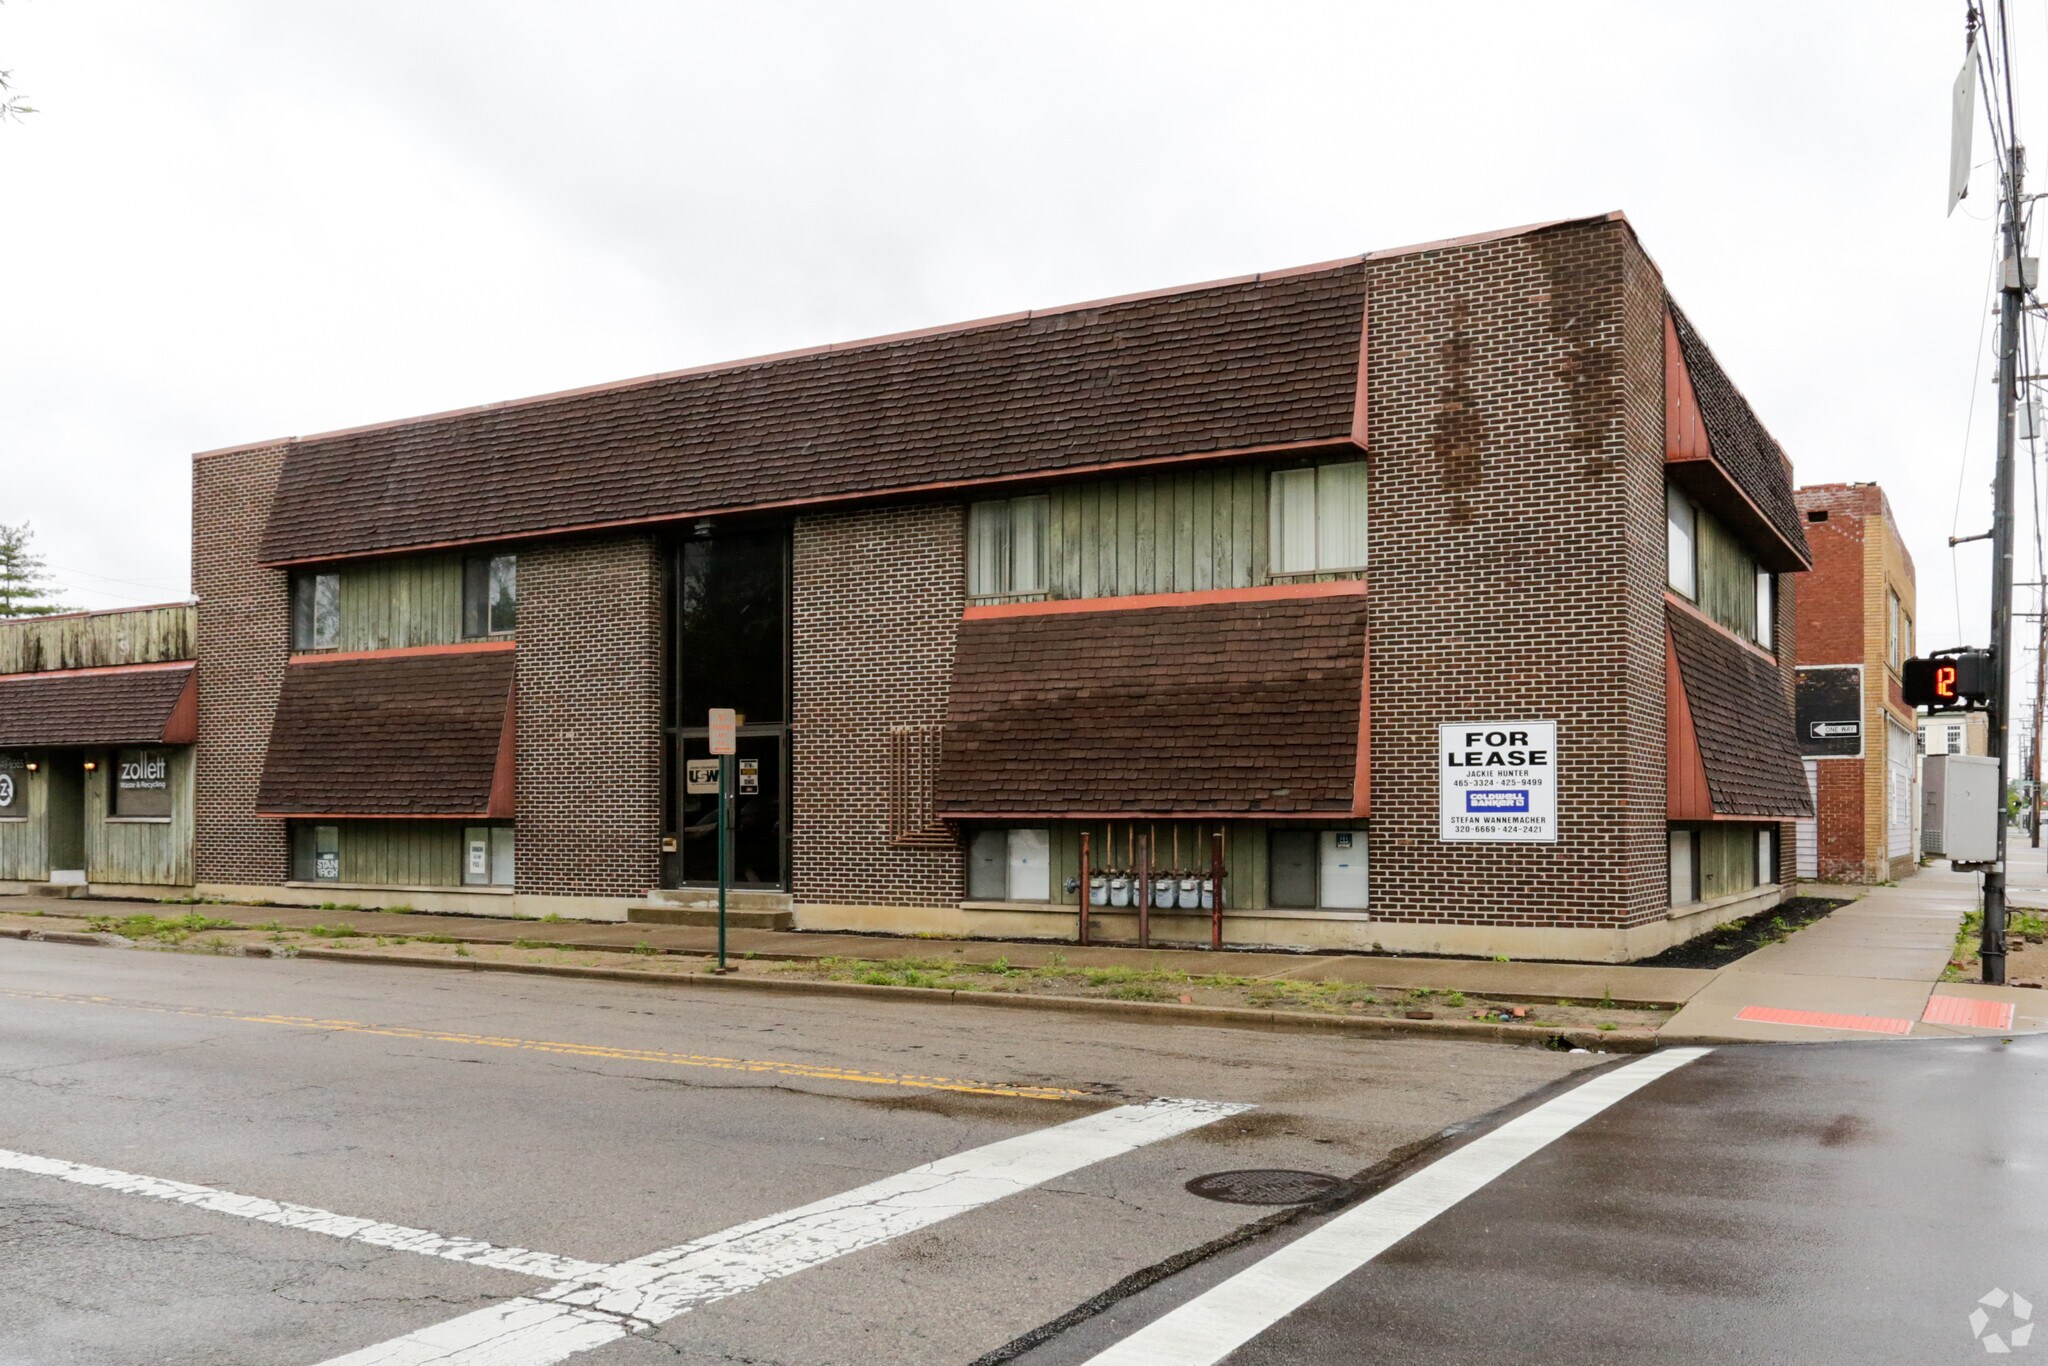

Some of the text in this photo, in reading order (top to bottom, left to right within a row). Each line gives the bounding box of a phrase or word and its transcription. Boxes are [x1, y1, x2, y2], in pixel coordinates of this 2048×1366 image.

[1937, 667, 1955, 697] 12
[1465, 731, 1529, 747] FOR
[1448, 750, 1548, 767] LEASE
[121, 751, 166, 780] zollett
[689, 769, 719, 783] USW
[1466, 769, 1529, 778] JACKIE HUNTER
[141, 780, 166, 789] Recycling
[1453, 778, 1543, 787] 465-3324 425-9499
[1450, 816, 1546, 824] STEFAN WANNEMACHER
[1455, 825, 1542, 833] 320-6669 424-2421
